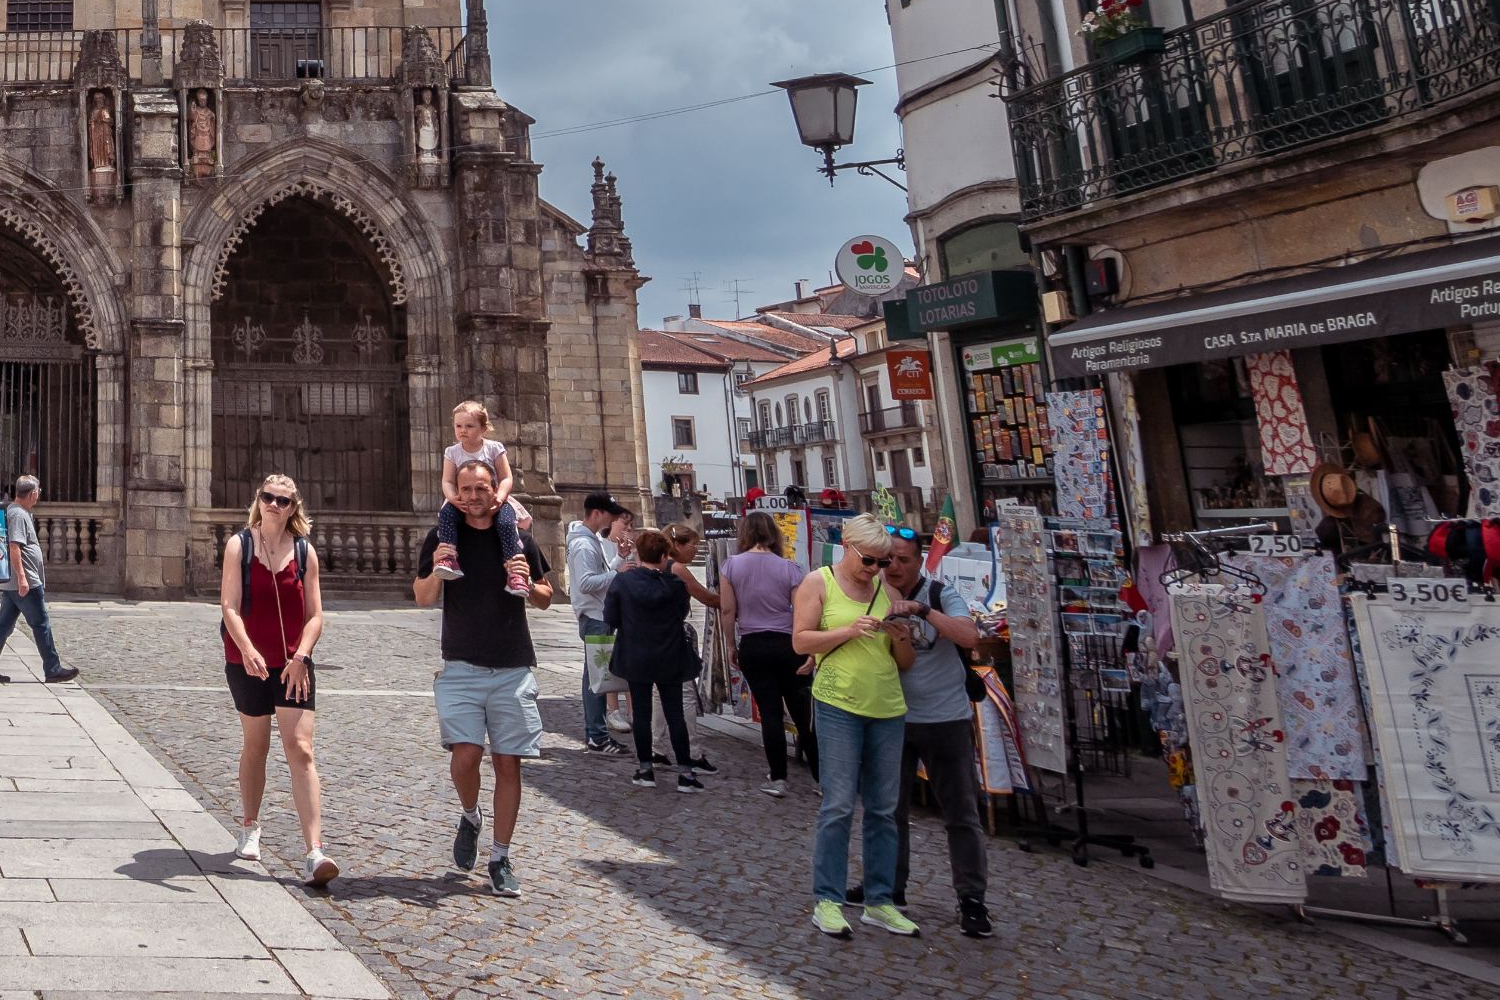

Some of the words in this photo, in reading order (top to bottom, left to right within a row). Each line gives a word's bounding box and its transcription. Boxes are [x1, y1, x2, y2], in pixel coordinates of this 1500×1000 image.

[855, 274, 890, 287] JOGOS
[916, 279, 978, 305] TOTOLOTO
[1430, 285, 1478, 304] Artigos
[919, 300, 976, 325] LOTARIAS
[1461, 301, 1500, 318] Portu
[1203, 333, 1237, 349] CASA
[1264, 322, 1308, 341] MARIA
[1325, 312, 1377, 332] BRAGA
[1071, 345, 1107, 360] Artigos
[1109, 337, 1162, 354] Religiosos
[1085, 352, 1150, 371] Paramentaria
[906, 370, 920, 378] CTT
[1251, 535, 1302, 557] 2,50
[1391, 583, 1468, 605] 3,50€
